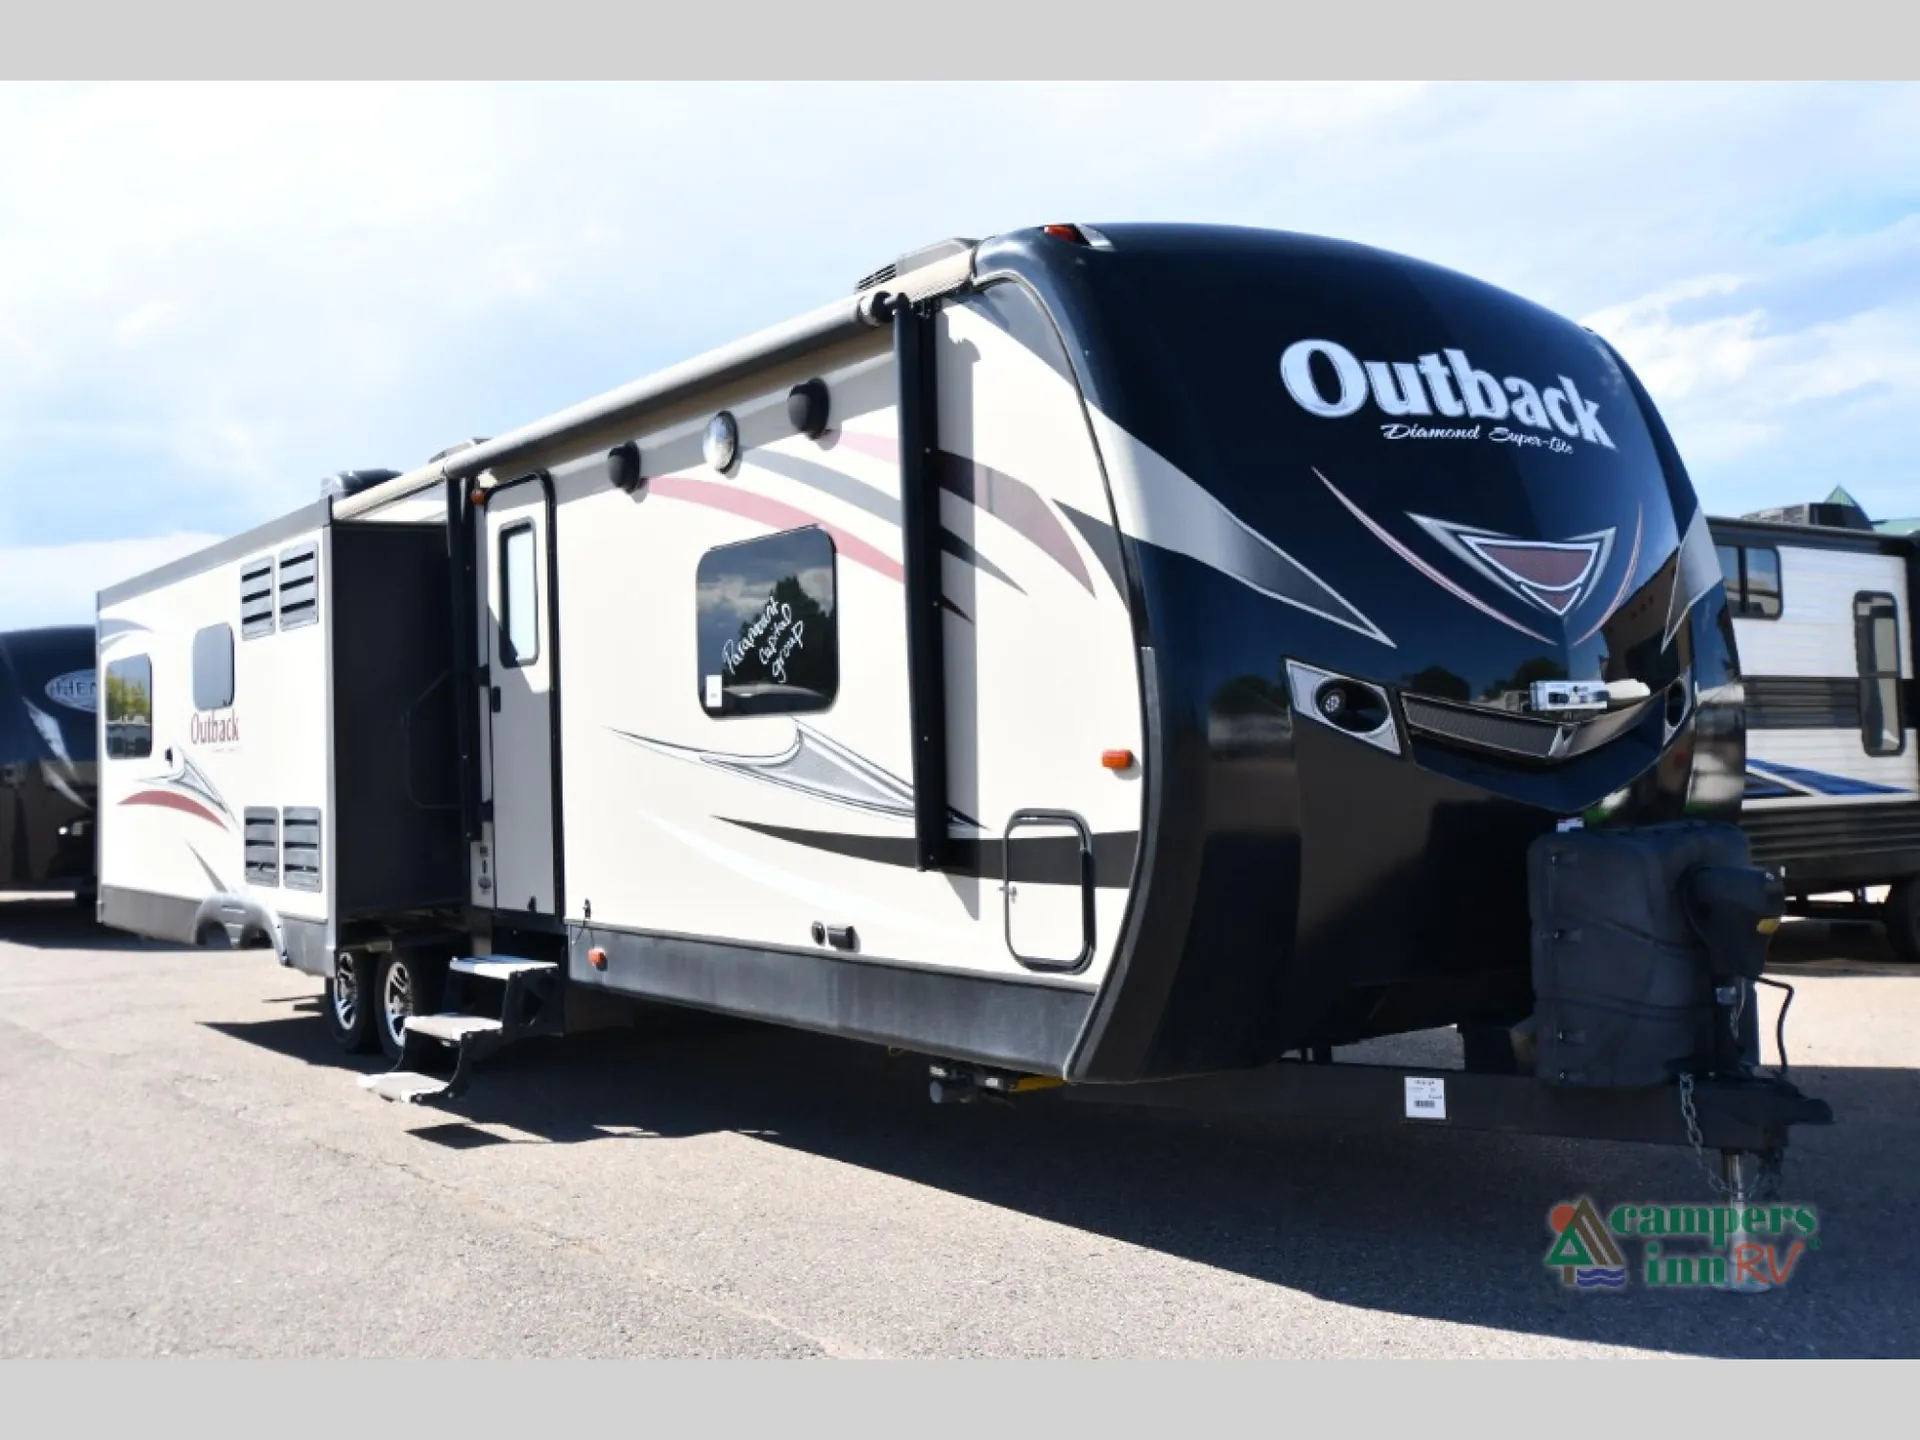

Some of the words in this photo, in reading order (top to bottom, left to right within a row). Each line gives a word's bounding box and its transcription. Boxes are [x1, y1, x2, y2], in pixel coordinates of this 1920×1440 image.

[1280, 339, 1616, 451] Outback
[1380, 423, 1480, 440] Diamond
[723, 595, 779, 675] Paramount
[772, 620, 804, 683] group
[191, 708, 239, 745] Outback
